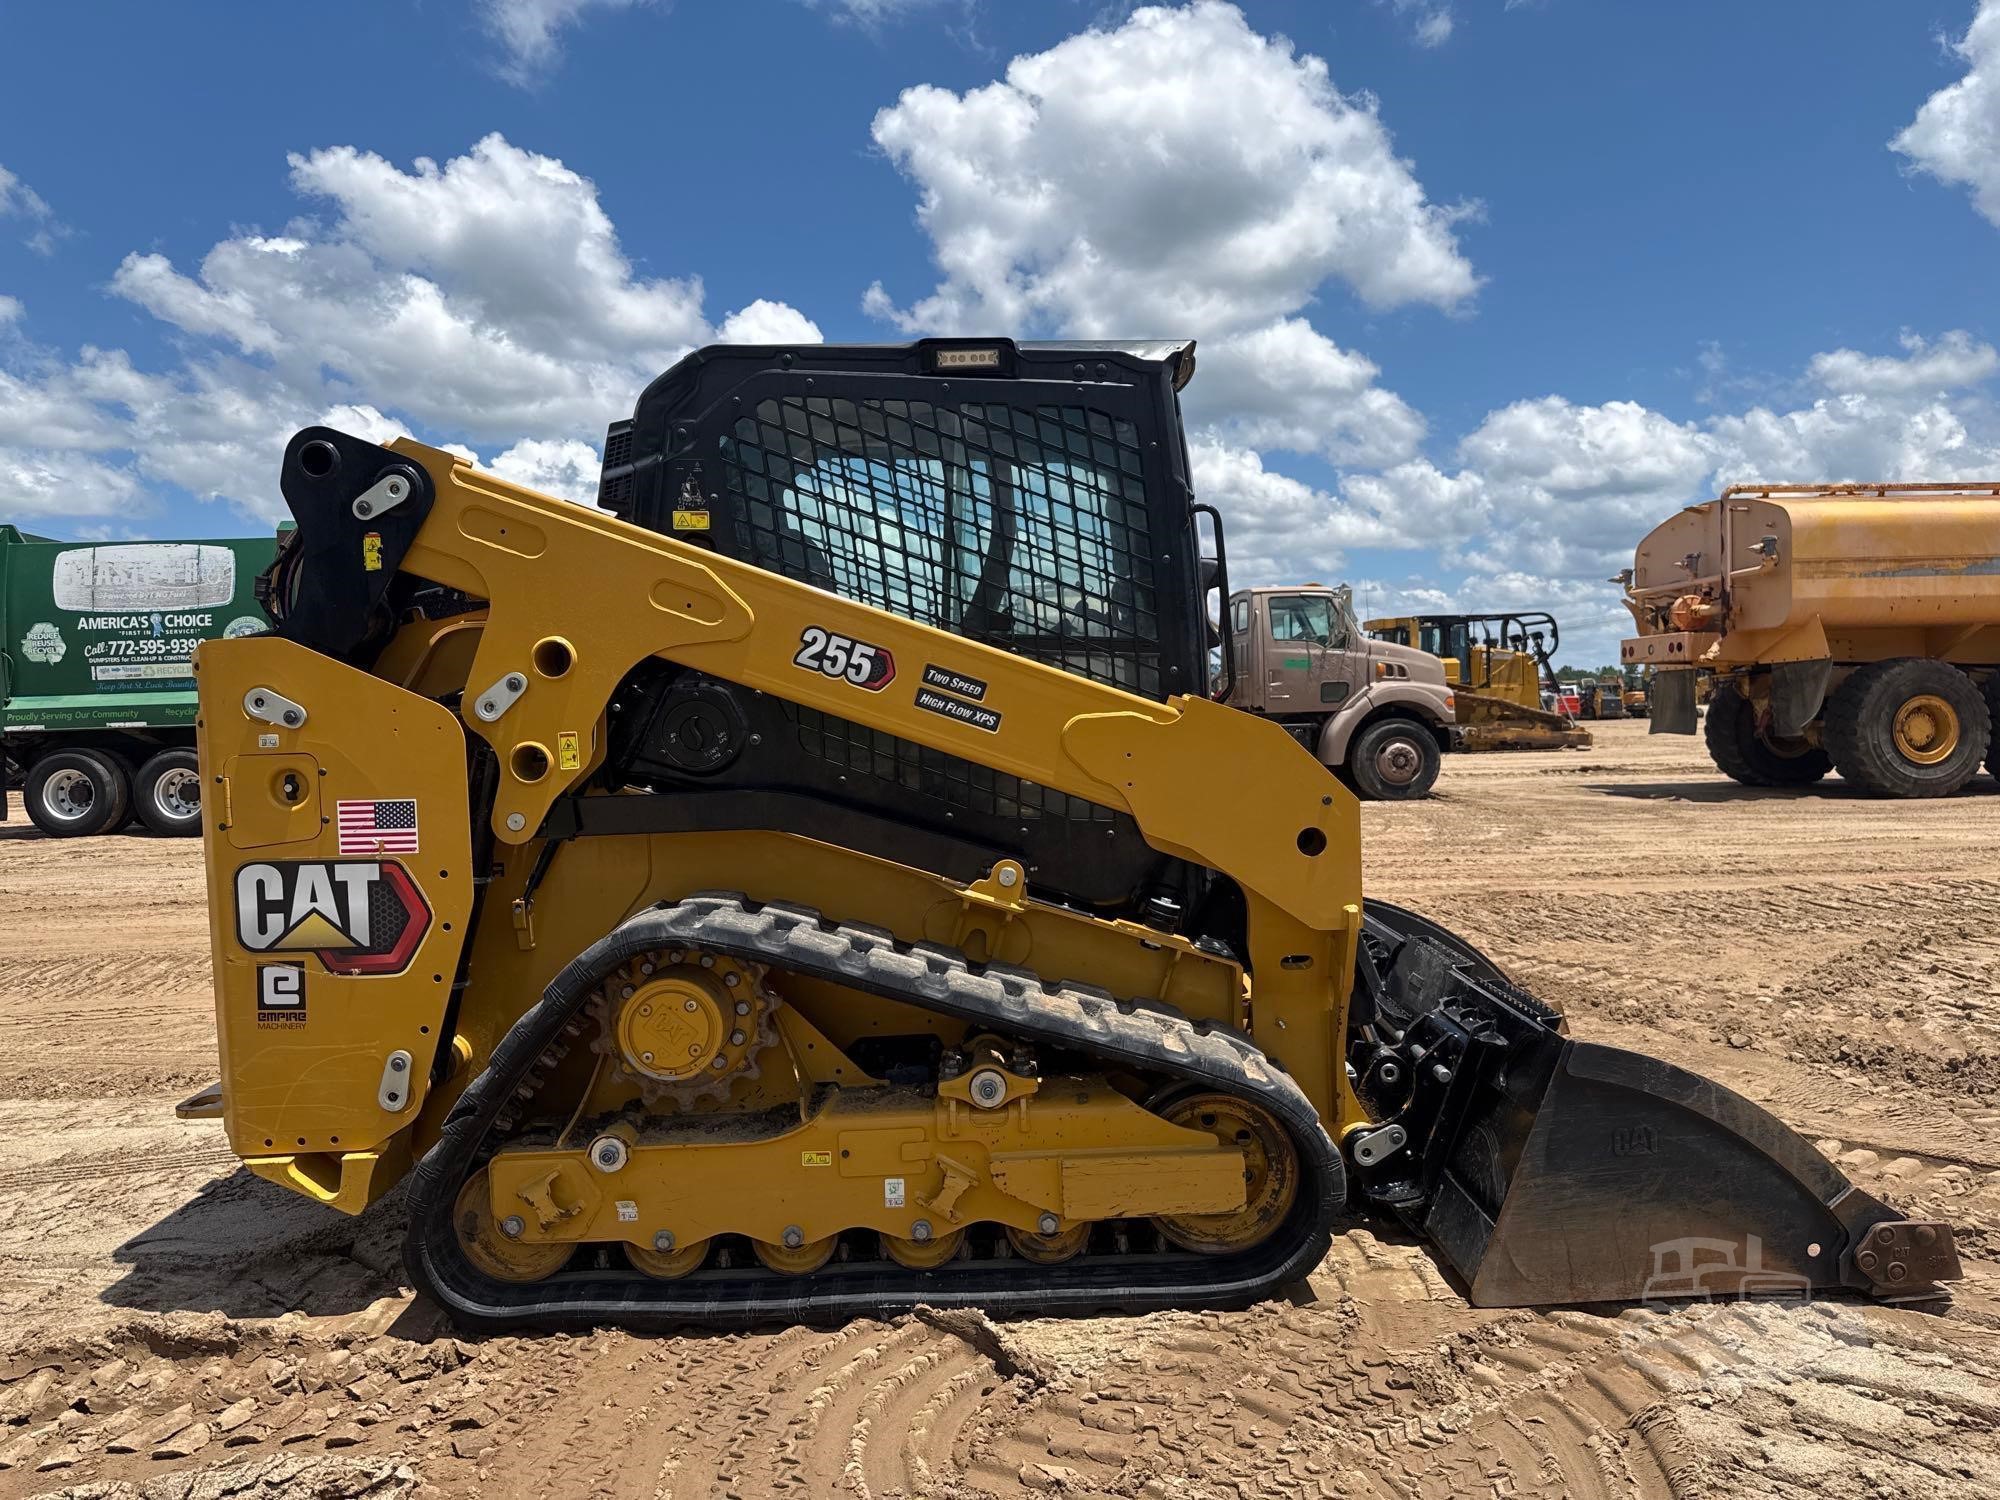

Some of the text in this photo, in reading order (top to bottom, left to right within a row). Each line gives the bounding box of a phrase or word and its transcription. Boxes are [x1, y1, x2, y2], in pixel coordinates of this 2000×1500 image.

[77, 616, 149, 630] AMERICA'S
[164, 614, 213, 627] CHOICE
[29, 632, 59, 640] REDUCE
[84, 641, 109, 657] Call:
[796, 628, 876, 683] 255
[88, 656, 121, 664] DUMPSTERS
[7, 711, 39, 721] Proudly
[41, 711, 73, 721] Serving
[75, 711, 90, 719] Our
[92, 708, 139, 718] Community
[973, 710, 997, 726] XPS
[238, 863, 380, 949] CAT
[257, 1022, 307, 1030] MACHINERY
[1612, 1126, 1660, 1157] CAT
